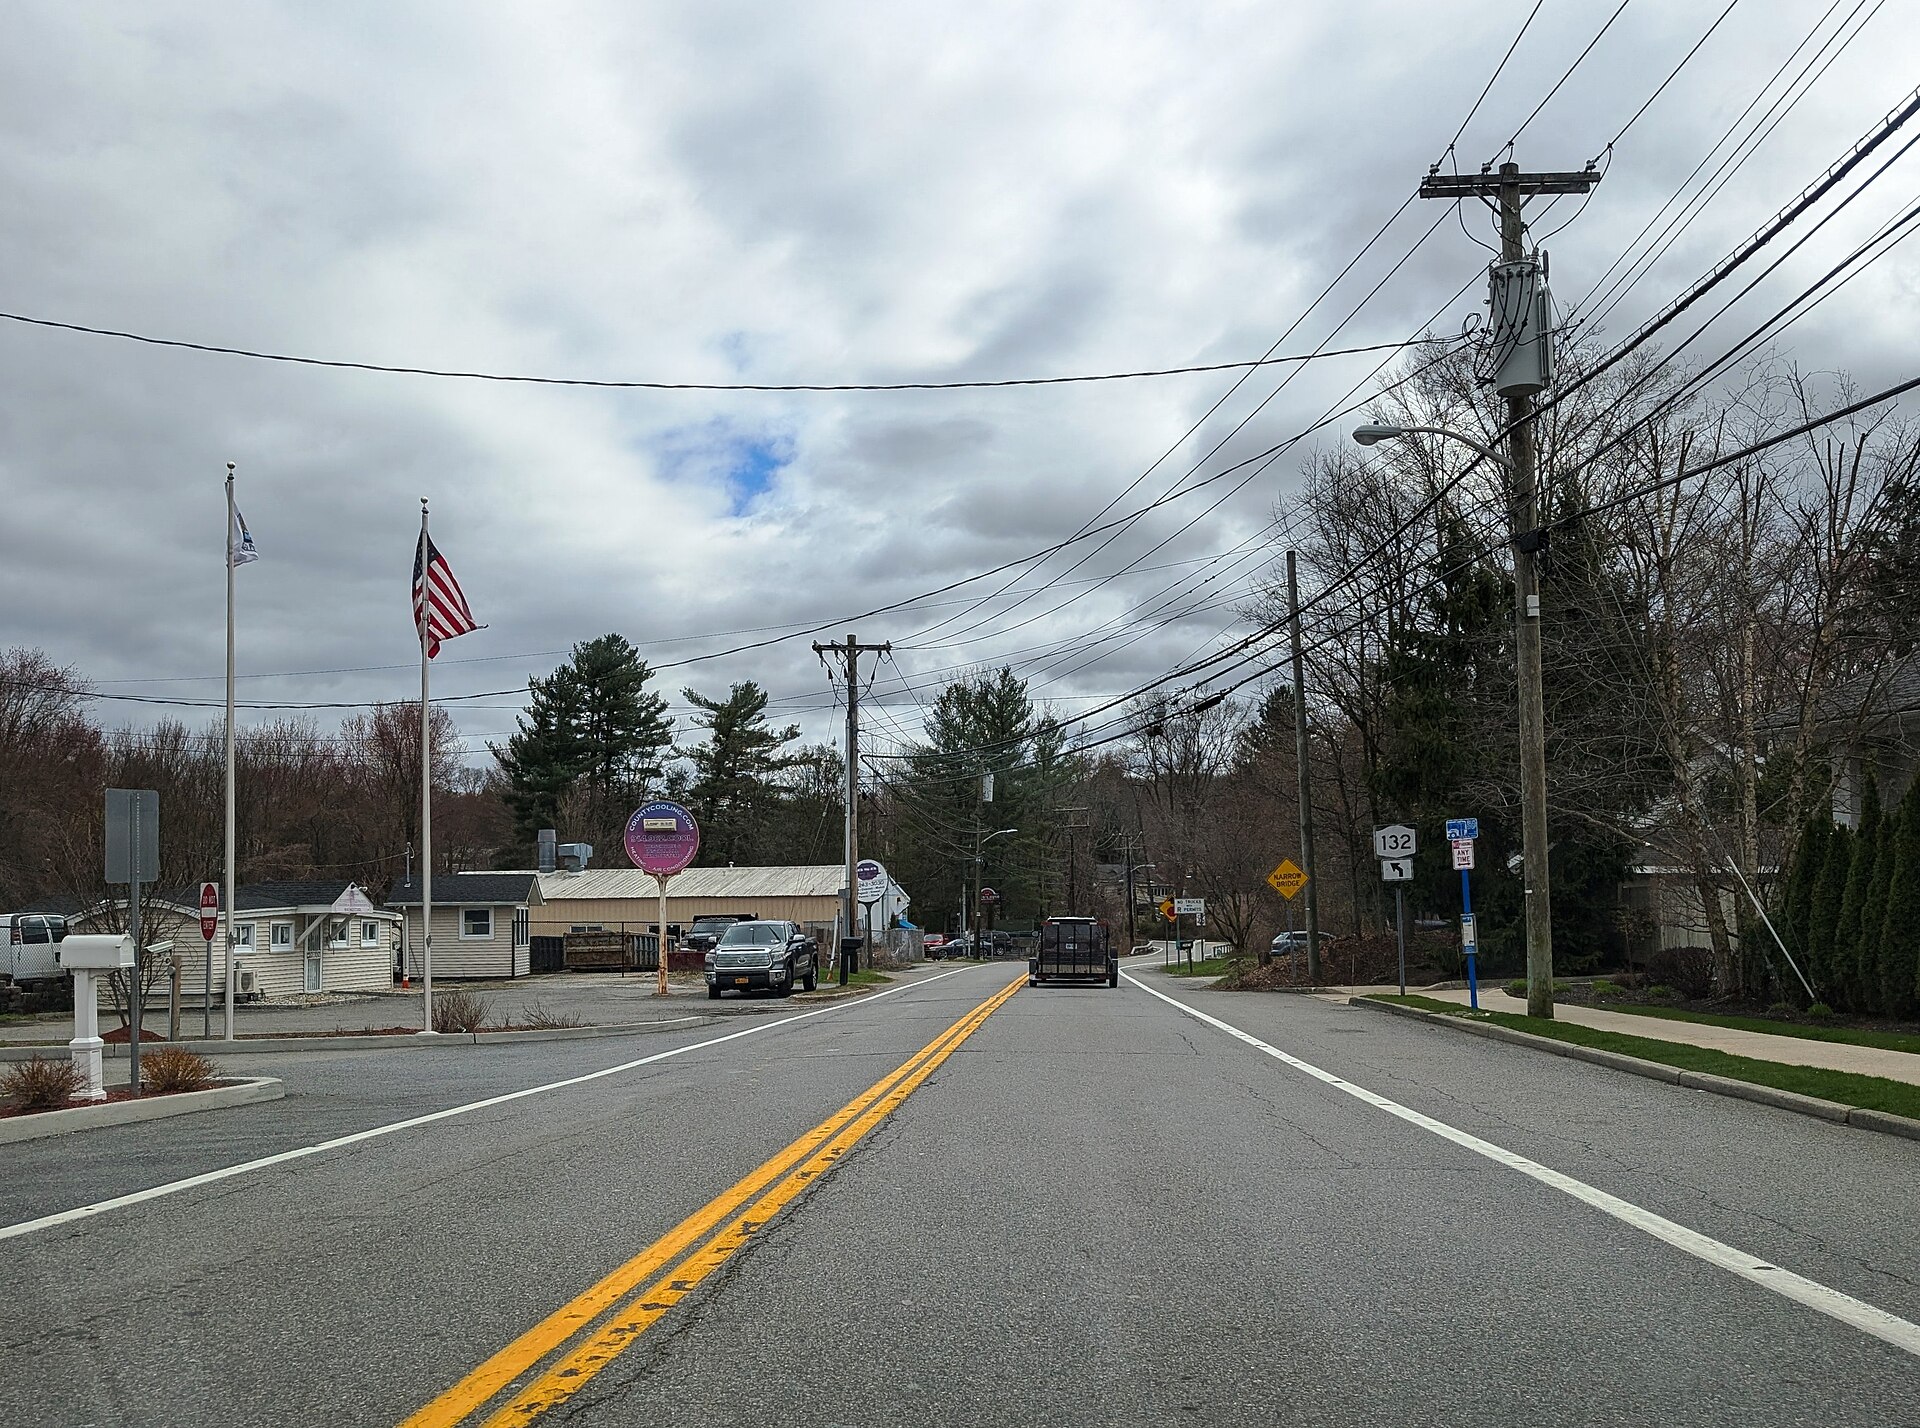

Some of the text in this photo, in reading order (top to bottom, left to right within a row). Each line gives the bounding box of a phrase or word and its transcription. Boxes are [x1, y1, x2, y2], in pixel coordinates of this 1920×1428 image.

[629, 804, 694, 832] COUNTYCOOLING.COM
[1381, 834, 1411, 850] 132
[630, 846, 647, 867] HEATING
[663, 846, 694, 872] CONDITIONING
[203, 895, 216, 904] DO NOT
[203, 920, 214, 929] ENTER
